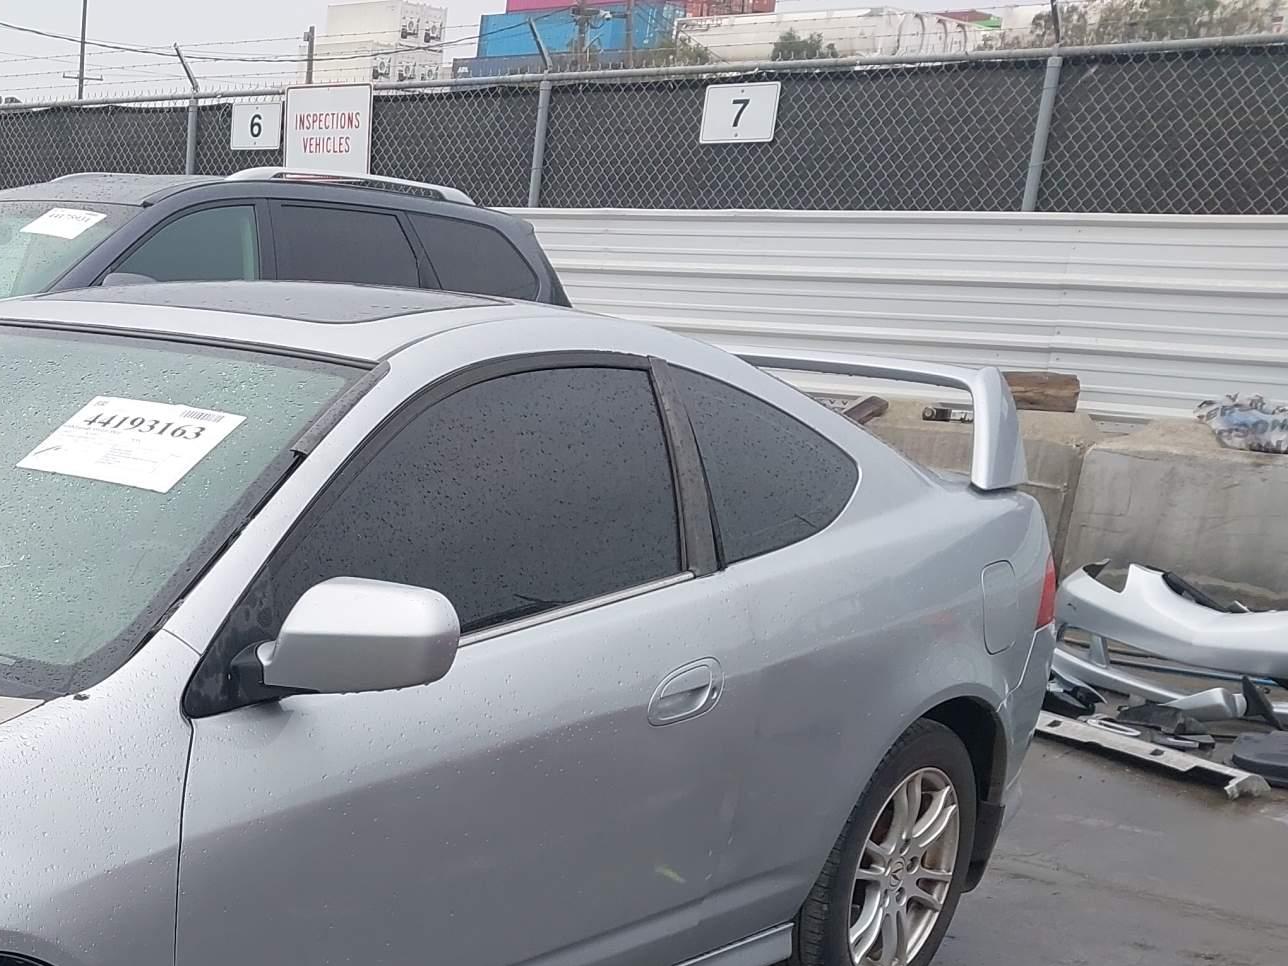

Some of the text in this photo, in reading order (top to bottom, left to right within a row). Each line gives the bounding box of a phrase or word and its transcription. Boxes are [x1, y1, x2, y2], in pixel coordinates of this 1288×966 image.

[249, 113, 263, 138] 6
[295, 111, 361, 130] INSPECTIONS
[730, 98, 751, 128] 7
[302, 136, 351, 154] VEHICLES
[83, 411, 207, 441] 44193163
